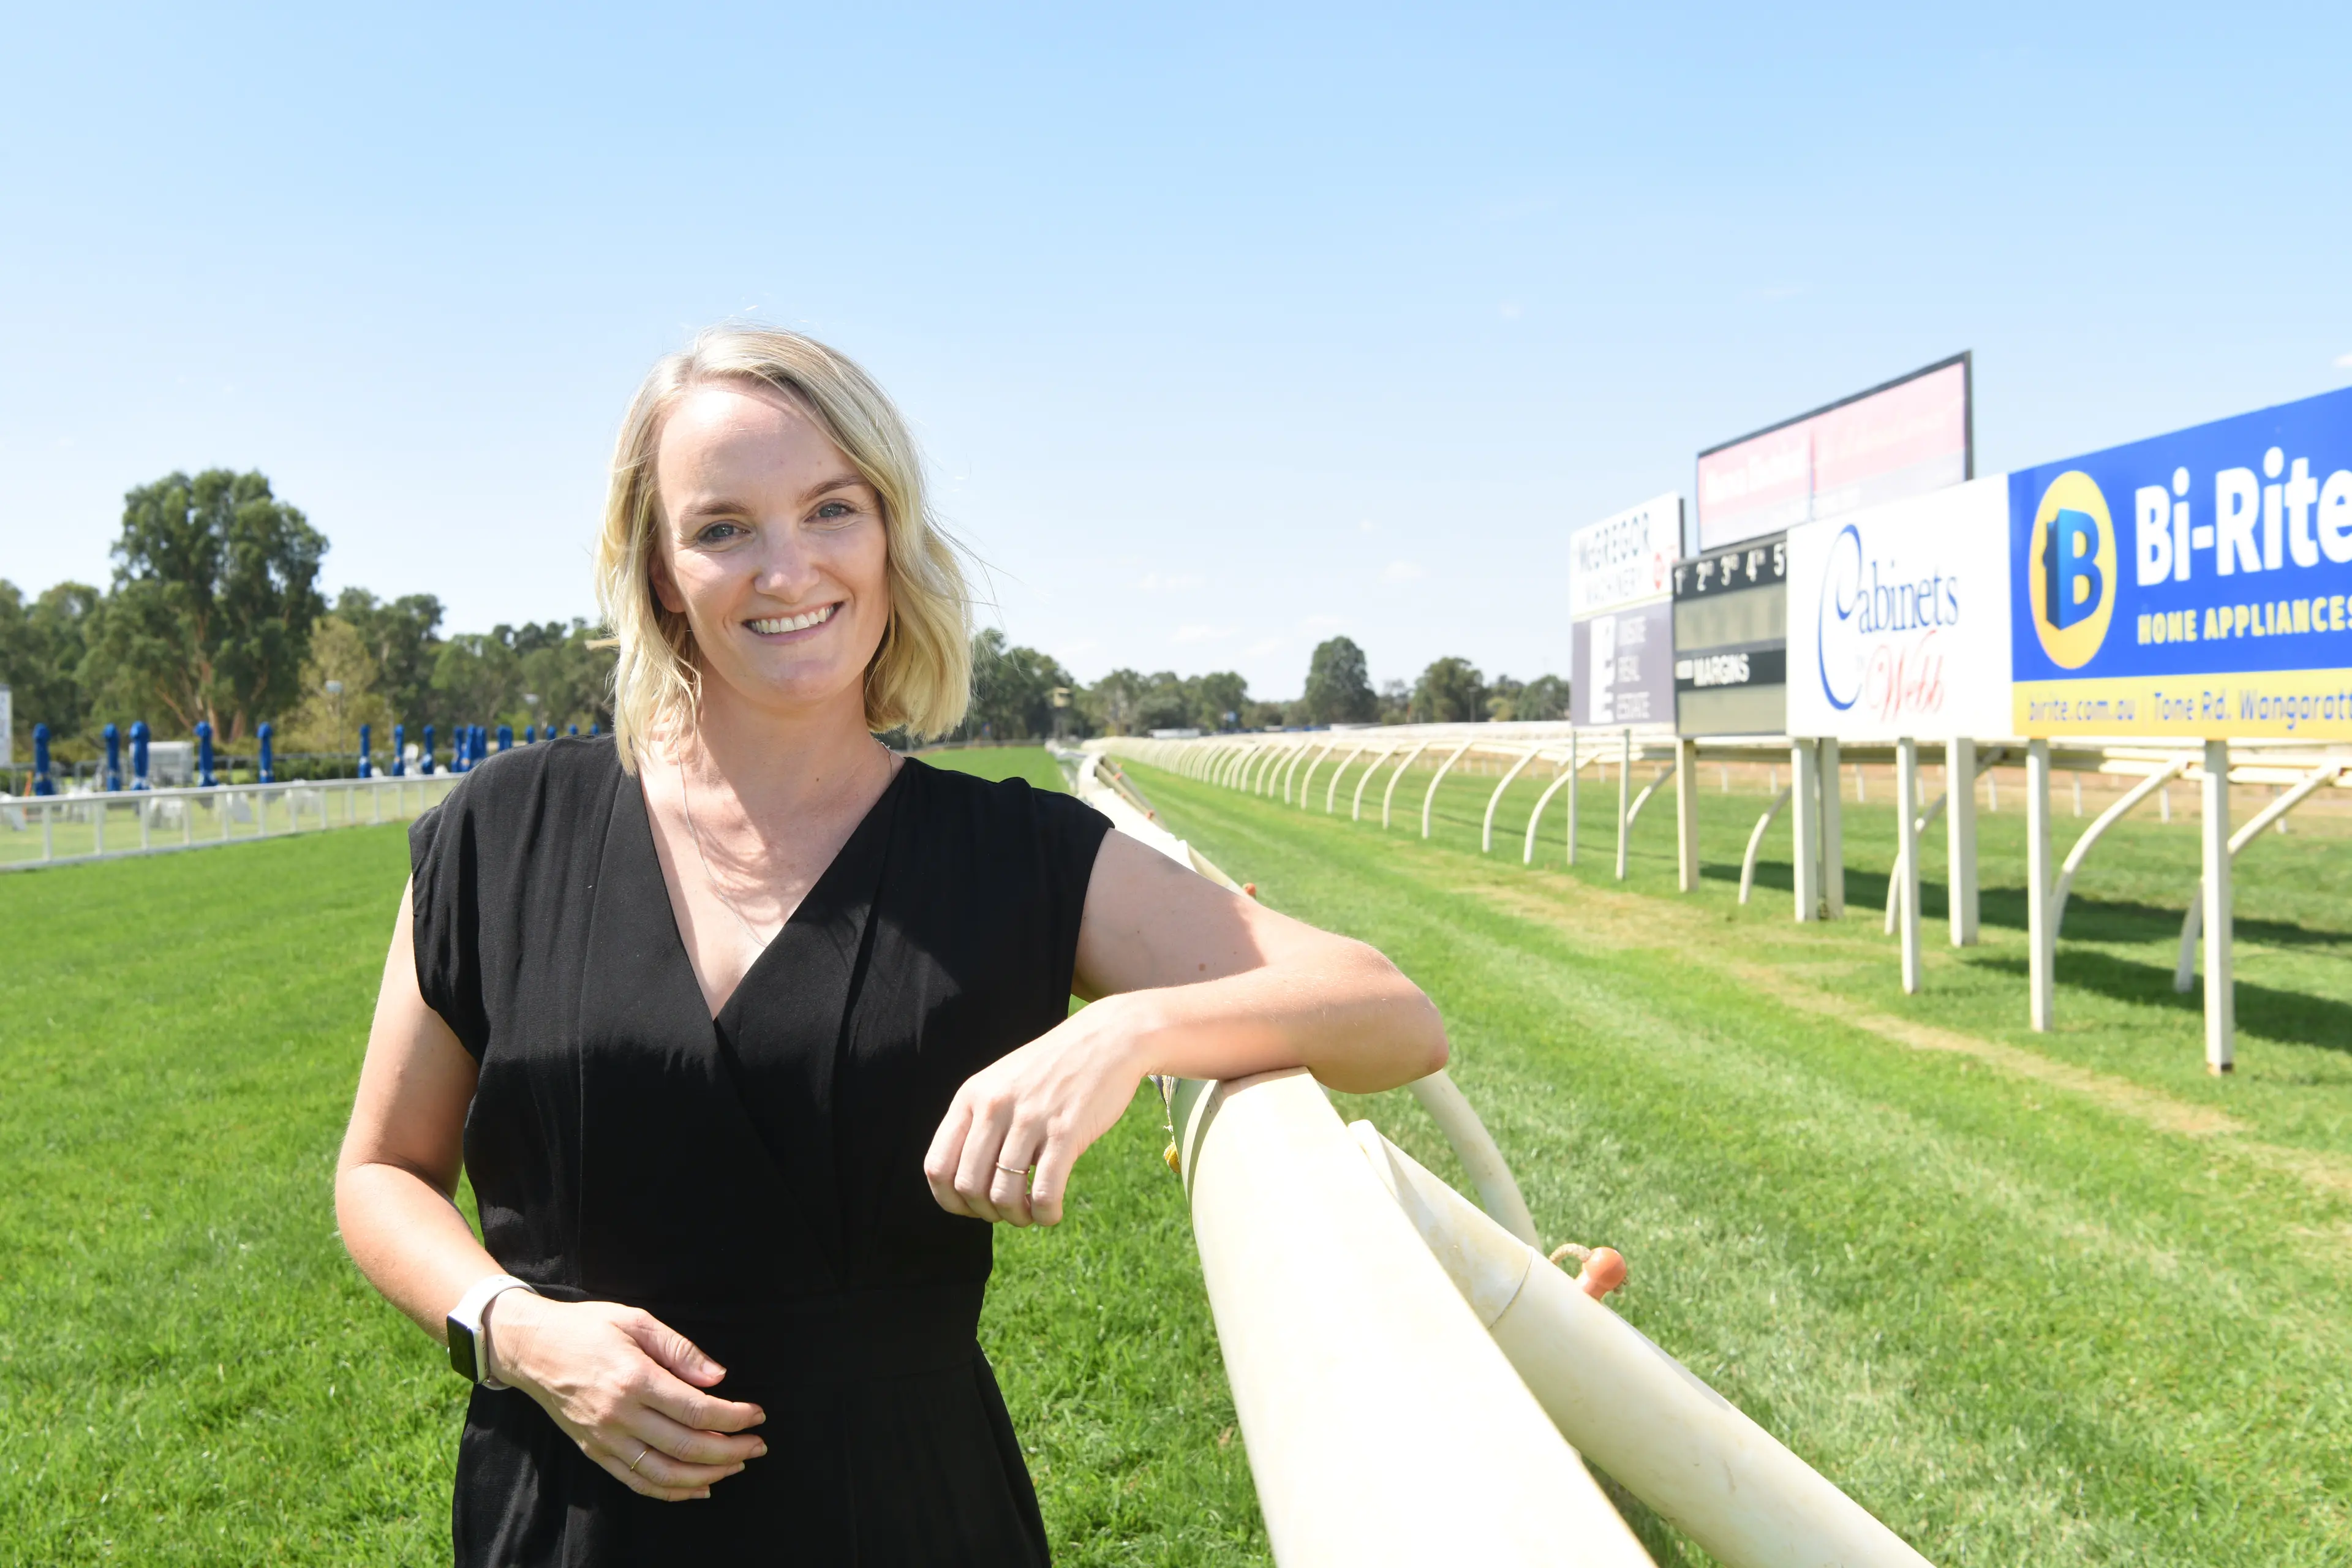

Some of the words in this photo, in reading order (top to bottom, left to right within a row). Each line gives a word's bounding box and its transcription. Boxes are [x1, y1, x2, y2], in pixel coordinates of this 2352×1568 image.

[2135, 447, 2352, 587] Bi-Rite
[1817, 524, 1959, 712] Cabinets
[2136, 609, 2198, 646] HOME
[2153, 691, 2195, 722] Tone
